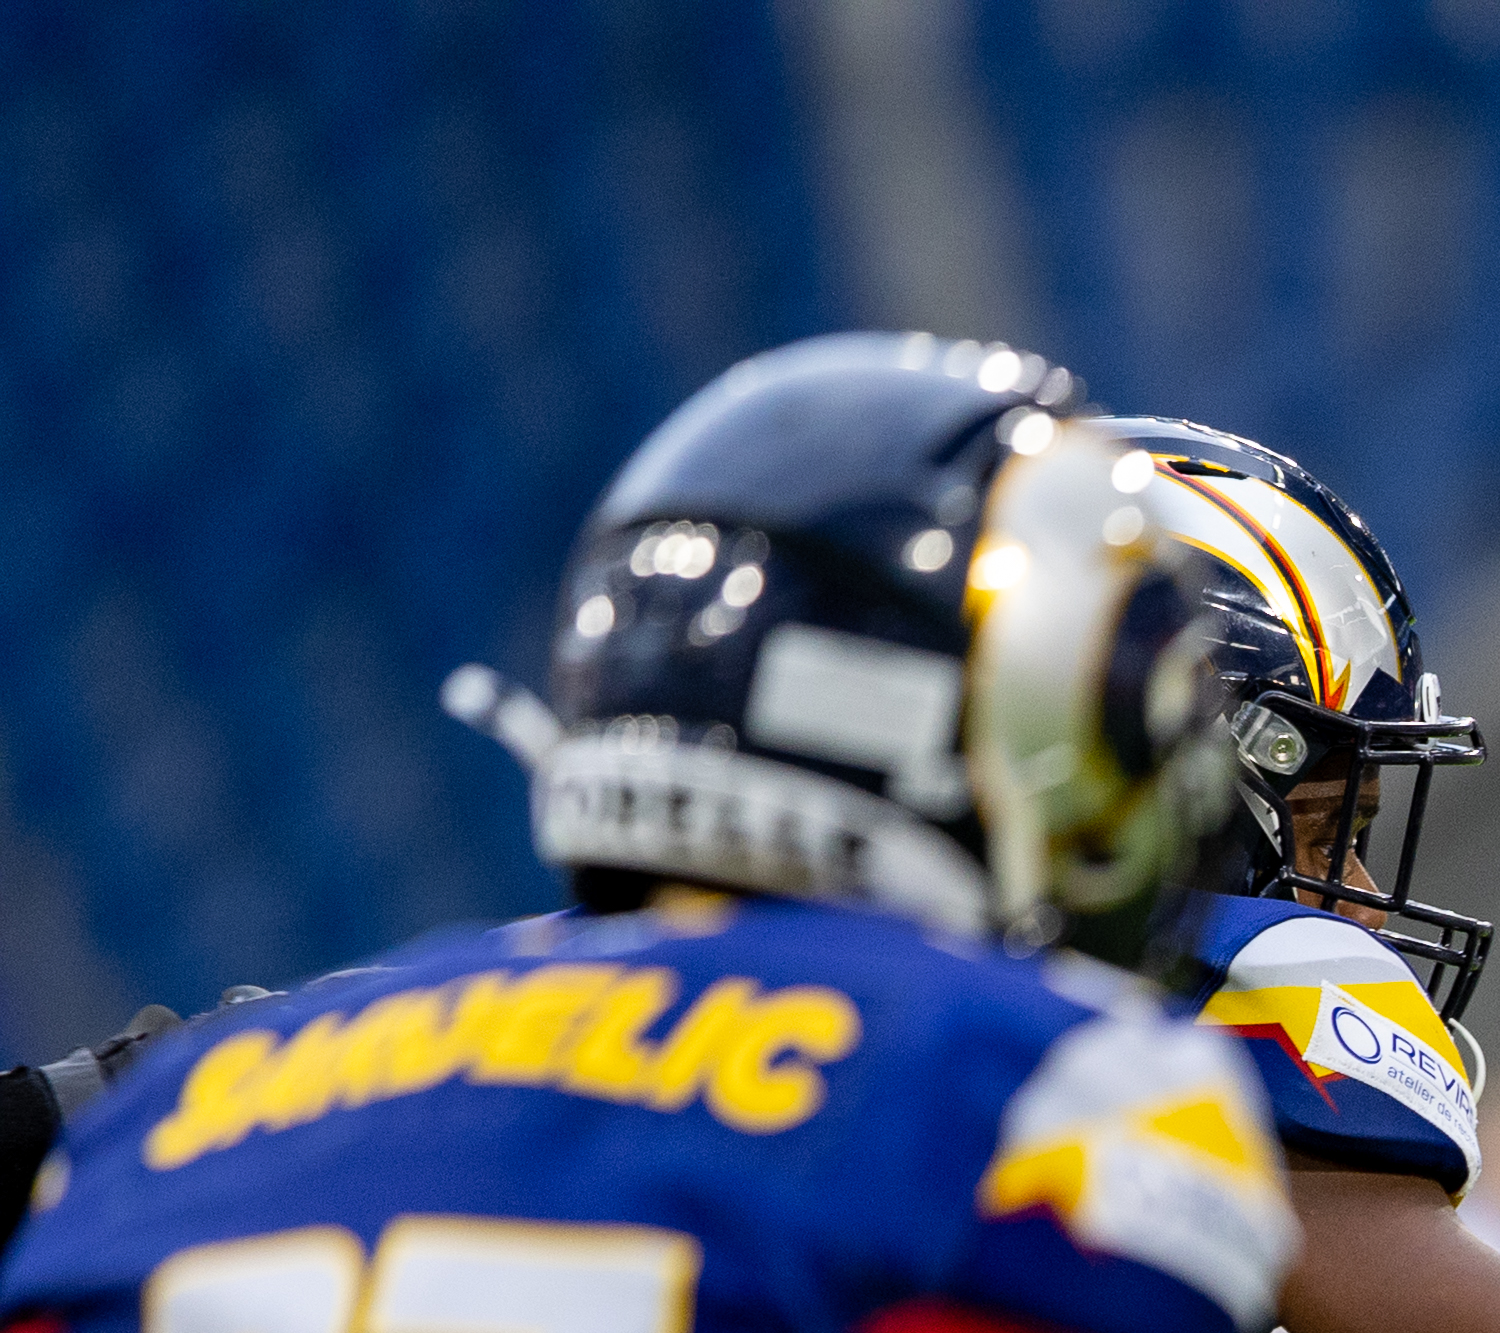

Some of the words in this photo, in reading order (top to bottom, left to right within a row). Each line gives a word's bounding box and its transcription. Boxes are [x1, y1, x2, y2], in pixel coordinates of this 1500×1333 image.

[1387, 1066, 1435, 1105] atelier
[1437, 1102, 1452, 1122] de
[1391, 1033, 1475, 1123] REVIR
